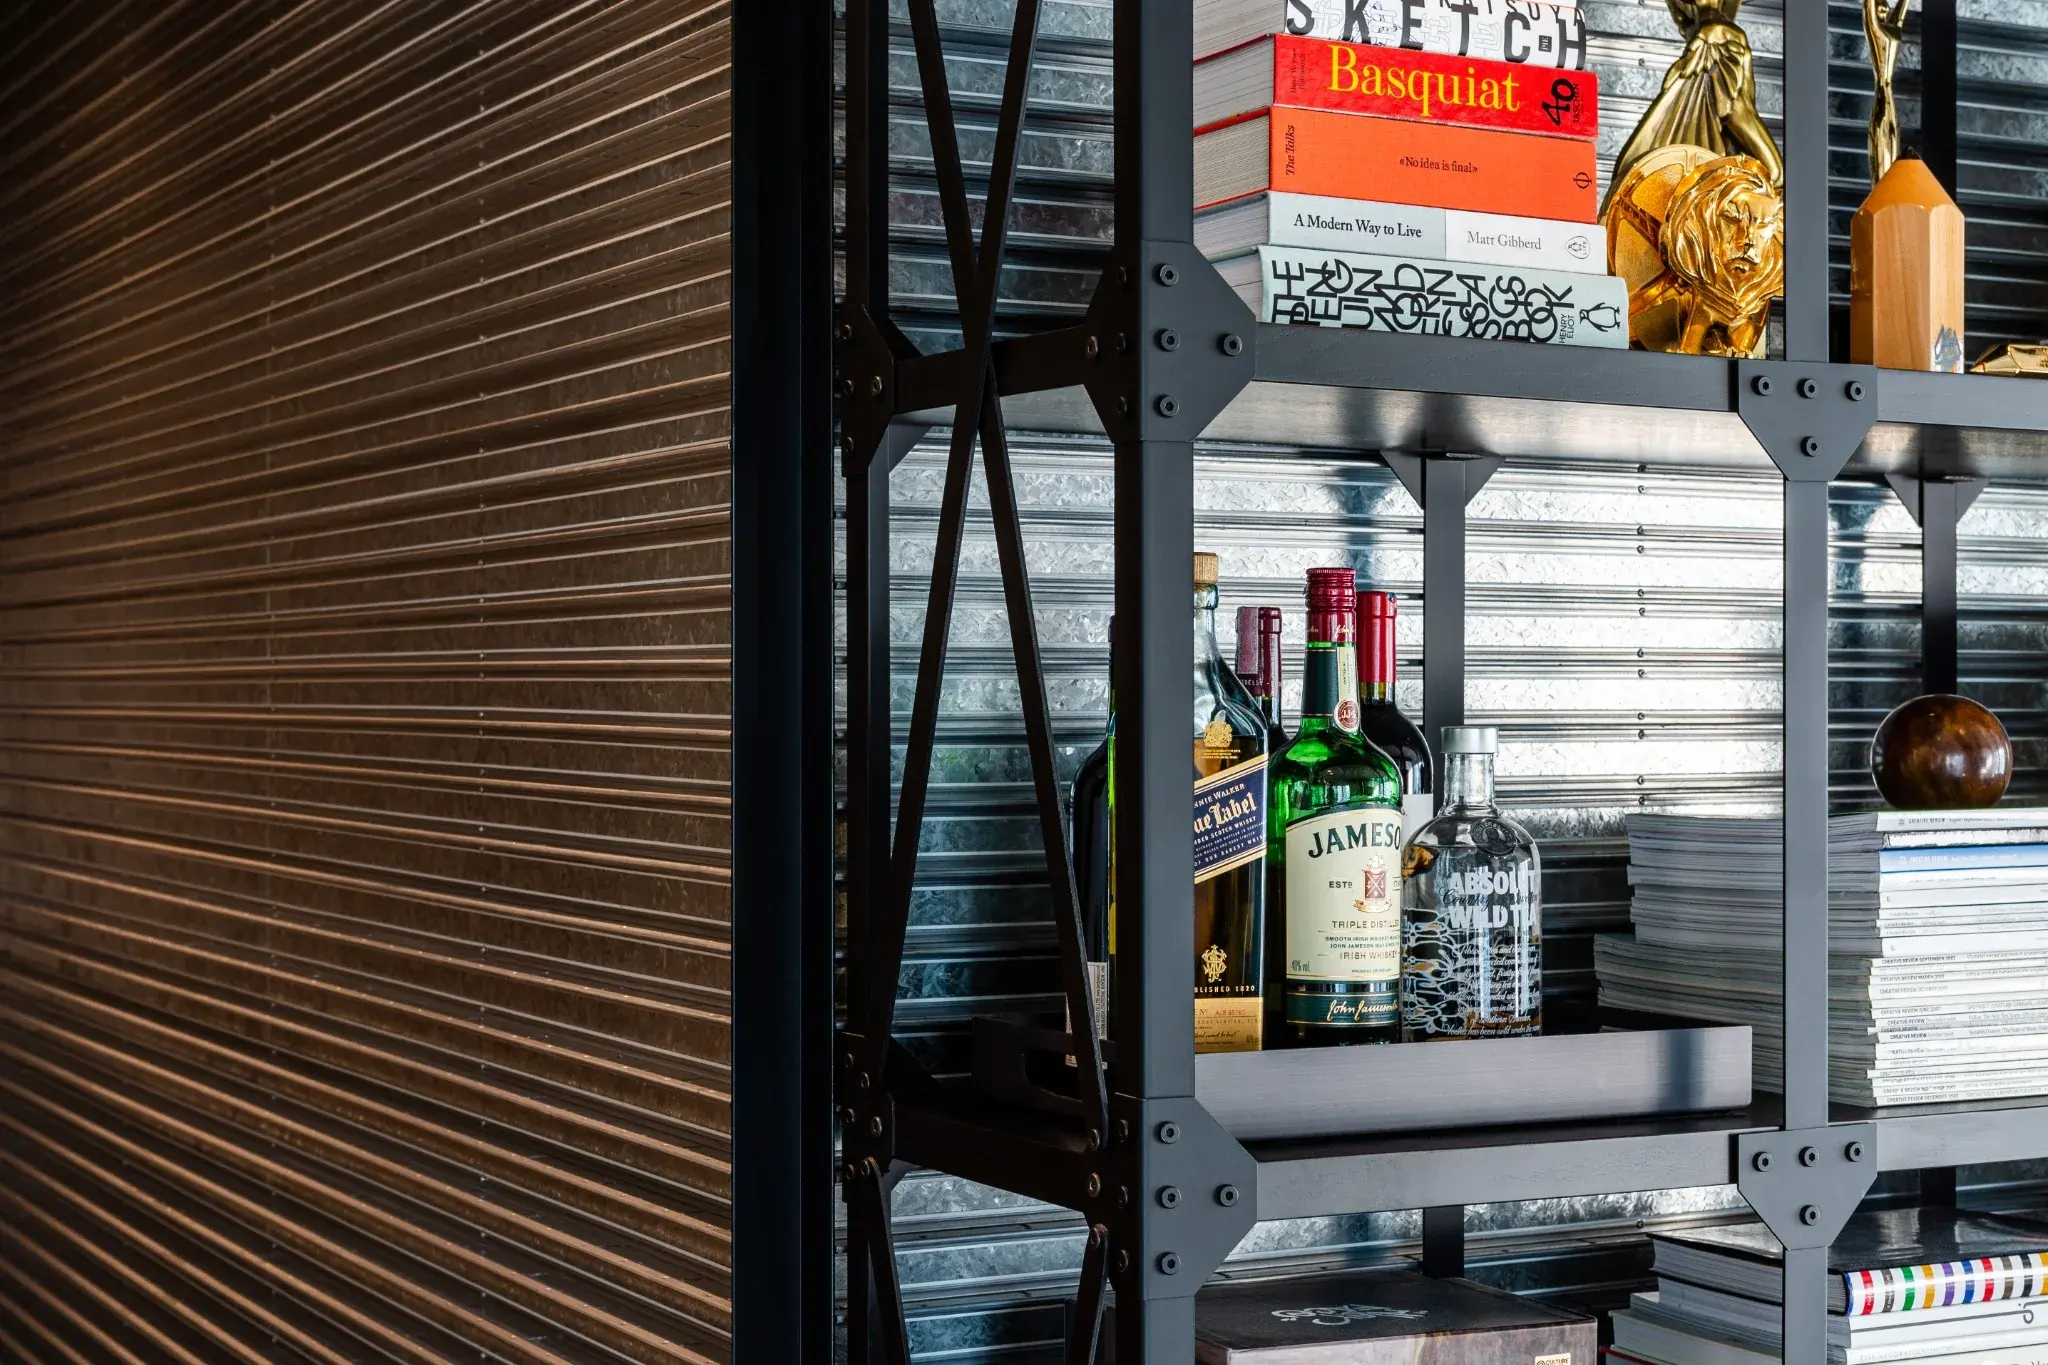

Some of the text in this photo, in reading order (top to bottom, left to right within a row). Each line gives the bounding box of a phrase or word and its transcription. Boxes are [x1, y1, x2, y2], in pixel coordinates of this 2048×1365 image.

[1287, 0, 1587, 71] SKETCH
[1327, 44, 1520, 117] Basquiat
[1541, 78, 1575, 126] 40
[1285, 125, 1296, 176] The Talks
[1420, 158, 1441, 171] idea
[1442, 161, 1450, 172] is
[1294, 214, 1422, 238] A Modern Way to Live
[1467, 231, 1542, 250] Matt Gibberd
[1559, 313, 1568, 344] HENRY
[1567, 314, 1575, 339] ELIOT
[1213, 783, 1245, 800] WALKER
[1209, 792, 1257, 829] Label
[1211, 826, 1232, 840] SCOTCH
[1234, 816, 1256, 830] WHISKY
[1308, 822, 1400, 858] JAMESO
[1448, 870, 1536, 895] ABSOLUT
[1332, 920, 1367, 929] TRIPLE
[1448, 905, 1508, 929] WILD
[1340, 952, 1366, 960] IRISH
[1327, 1000, 1355, 1022] John
